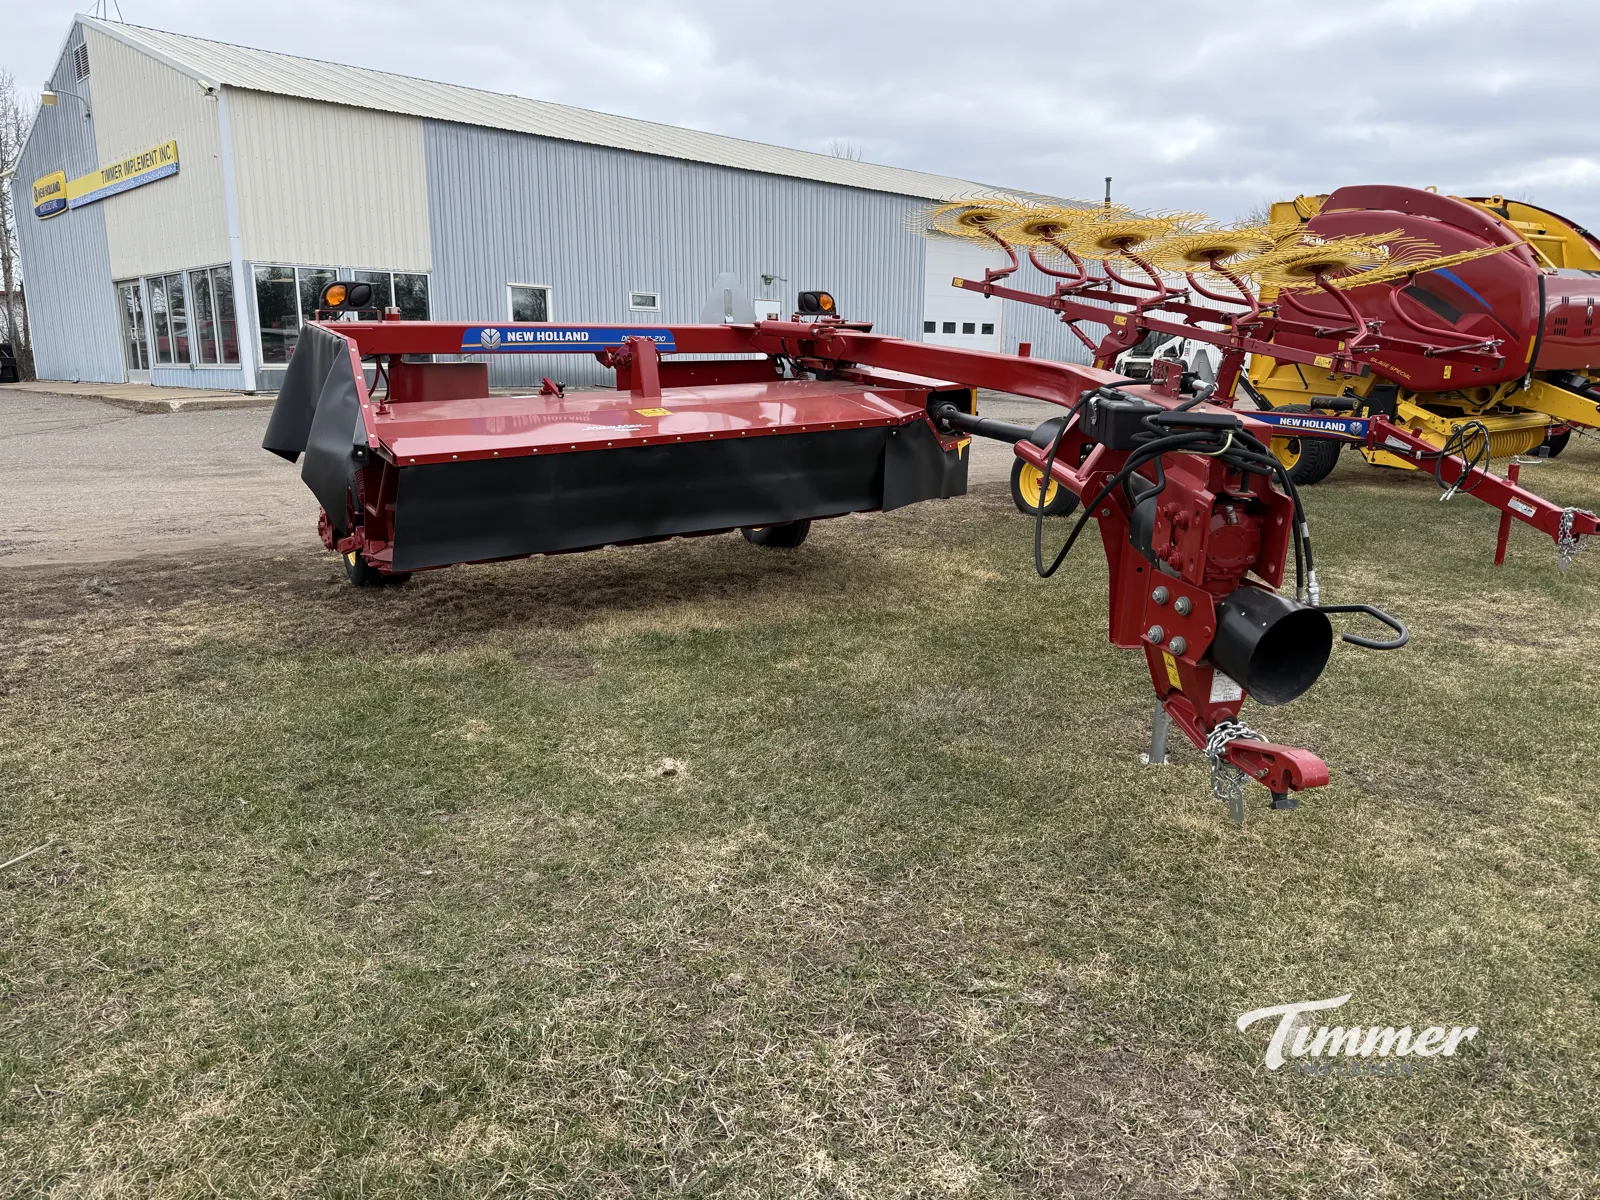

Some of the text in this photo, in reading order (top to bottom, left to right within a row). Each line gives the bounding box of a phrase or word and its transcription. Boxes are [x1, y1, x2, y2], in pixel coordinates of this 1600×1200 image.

[101, 144, 174, 184] TIMMER IMPLEMENT INC.
[507, 331, 589, 342] NEW HOLLAND
[1370, 357, 1412, 381] SILAGE SPECIAL
[1279, 417, 1346, 432] NEW HOLLAND
